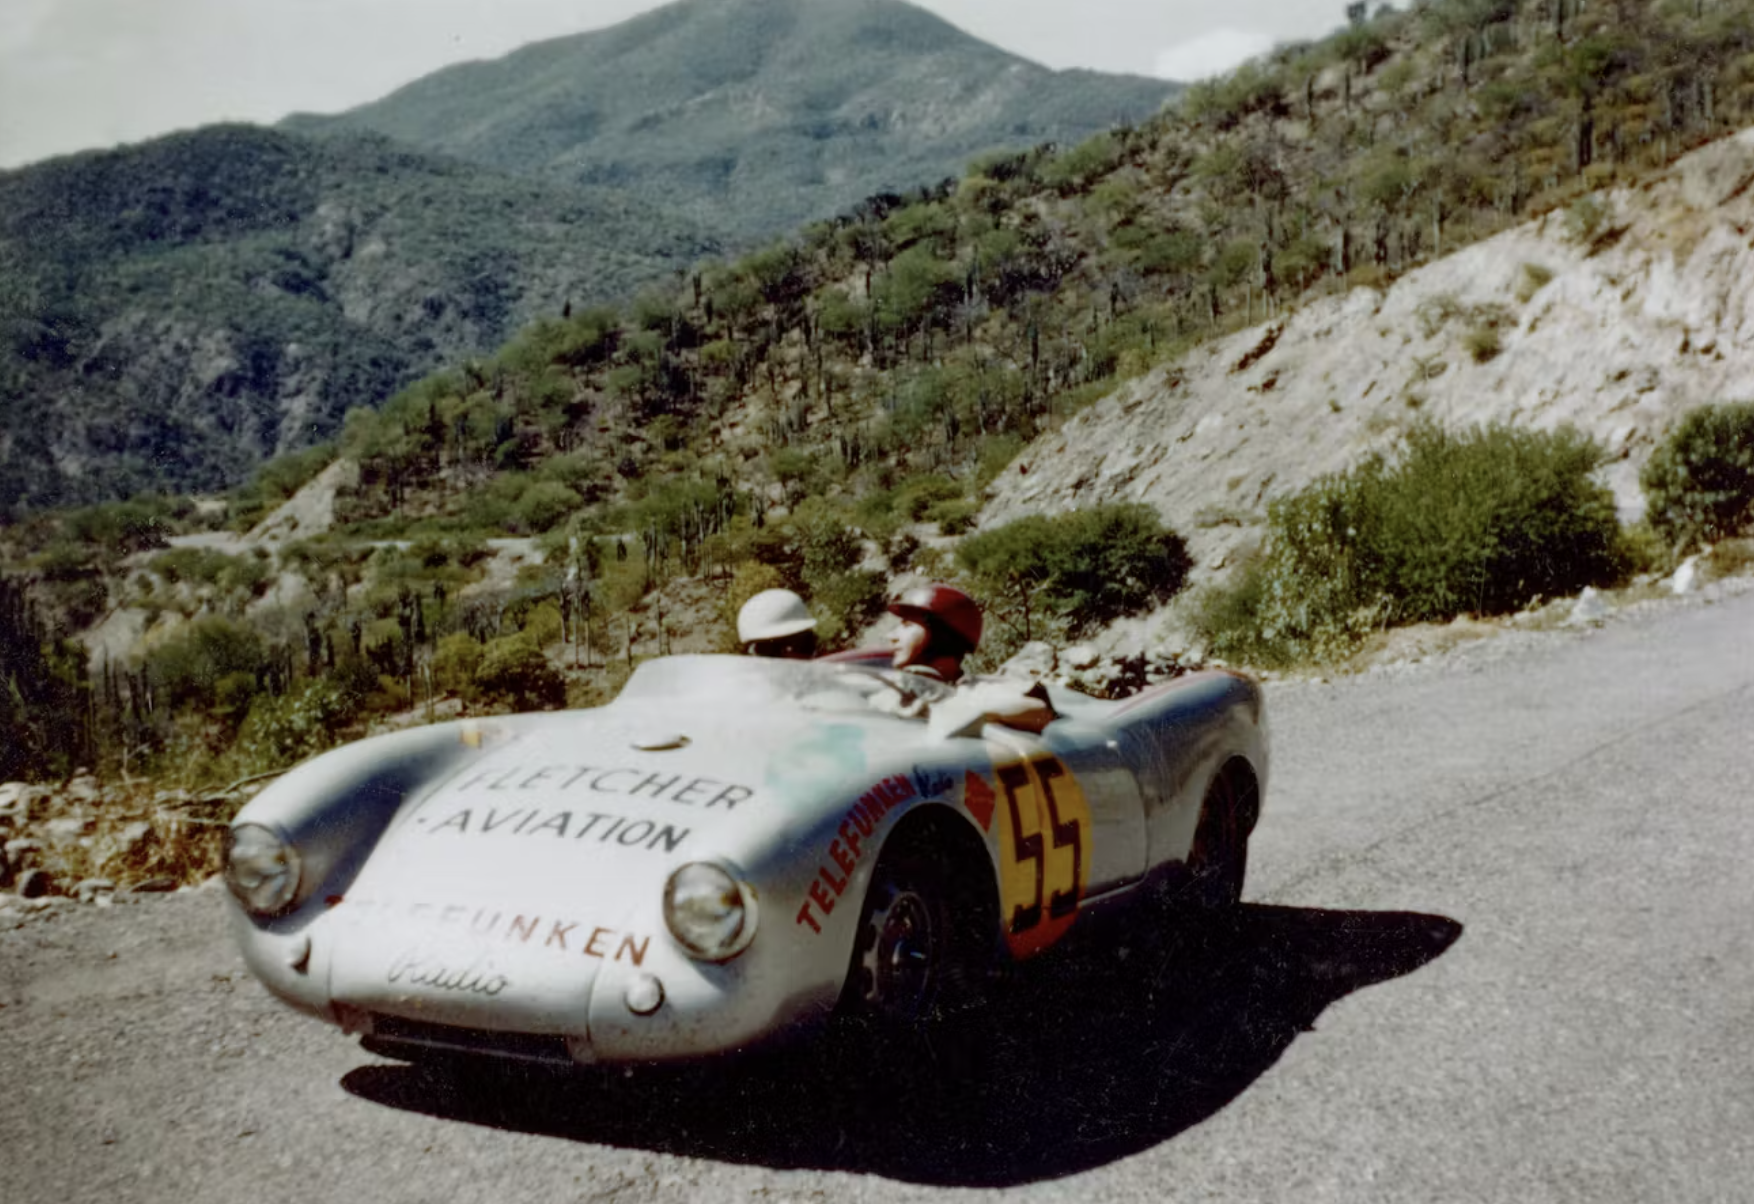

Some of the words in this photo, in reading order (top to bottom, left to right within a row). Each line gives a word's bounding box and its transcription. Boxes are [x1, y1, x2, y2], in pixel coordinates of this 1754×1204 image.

[457, 765, 755, 810] FLETCHER
[427, 807, 691, 854] AVIATION
[796, 773, 918, 935] TELEFUNKEN
[995, 752, 1082, 934] 55
[325, 895, 651, 967] FUNKEN
